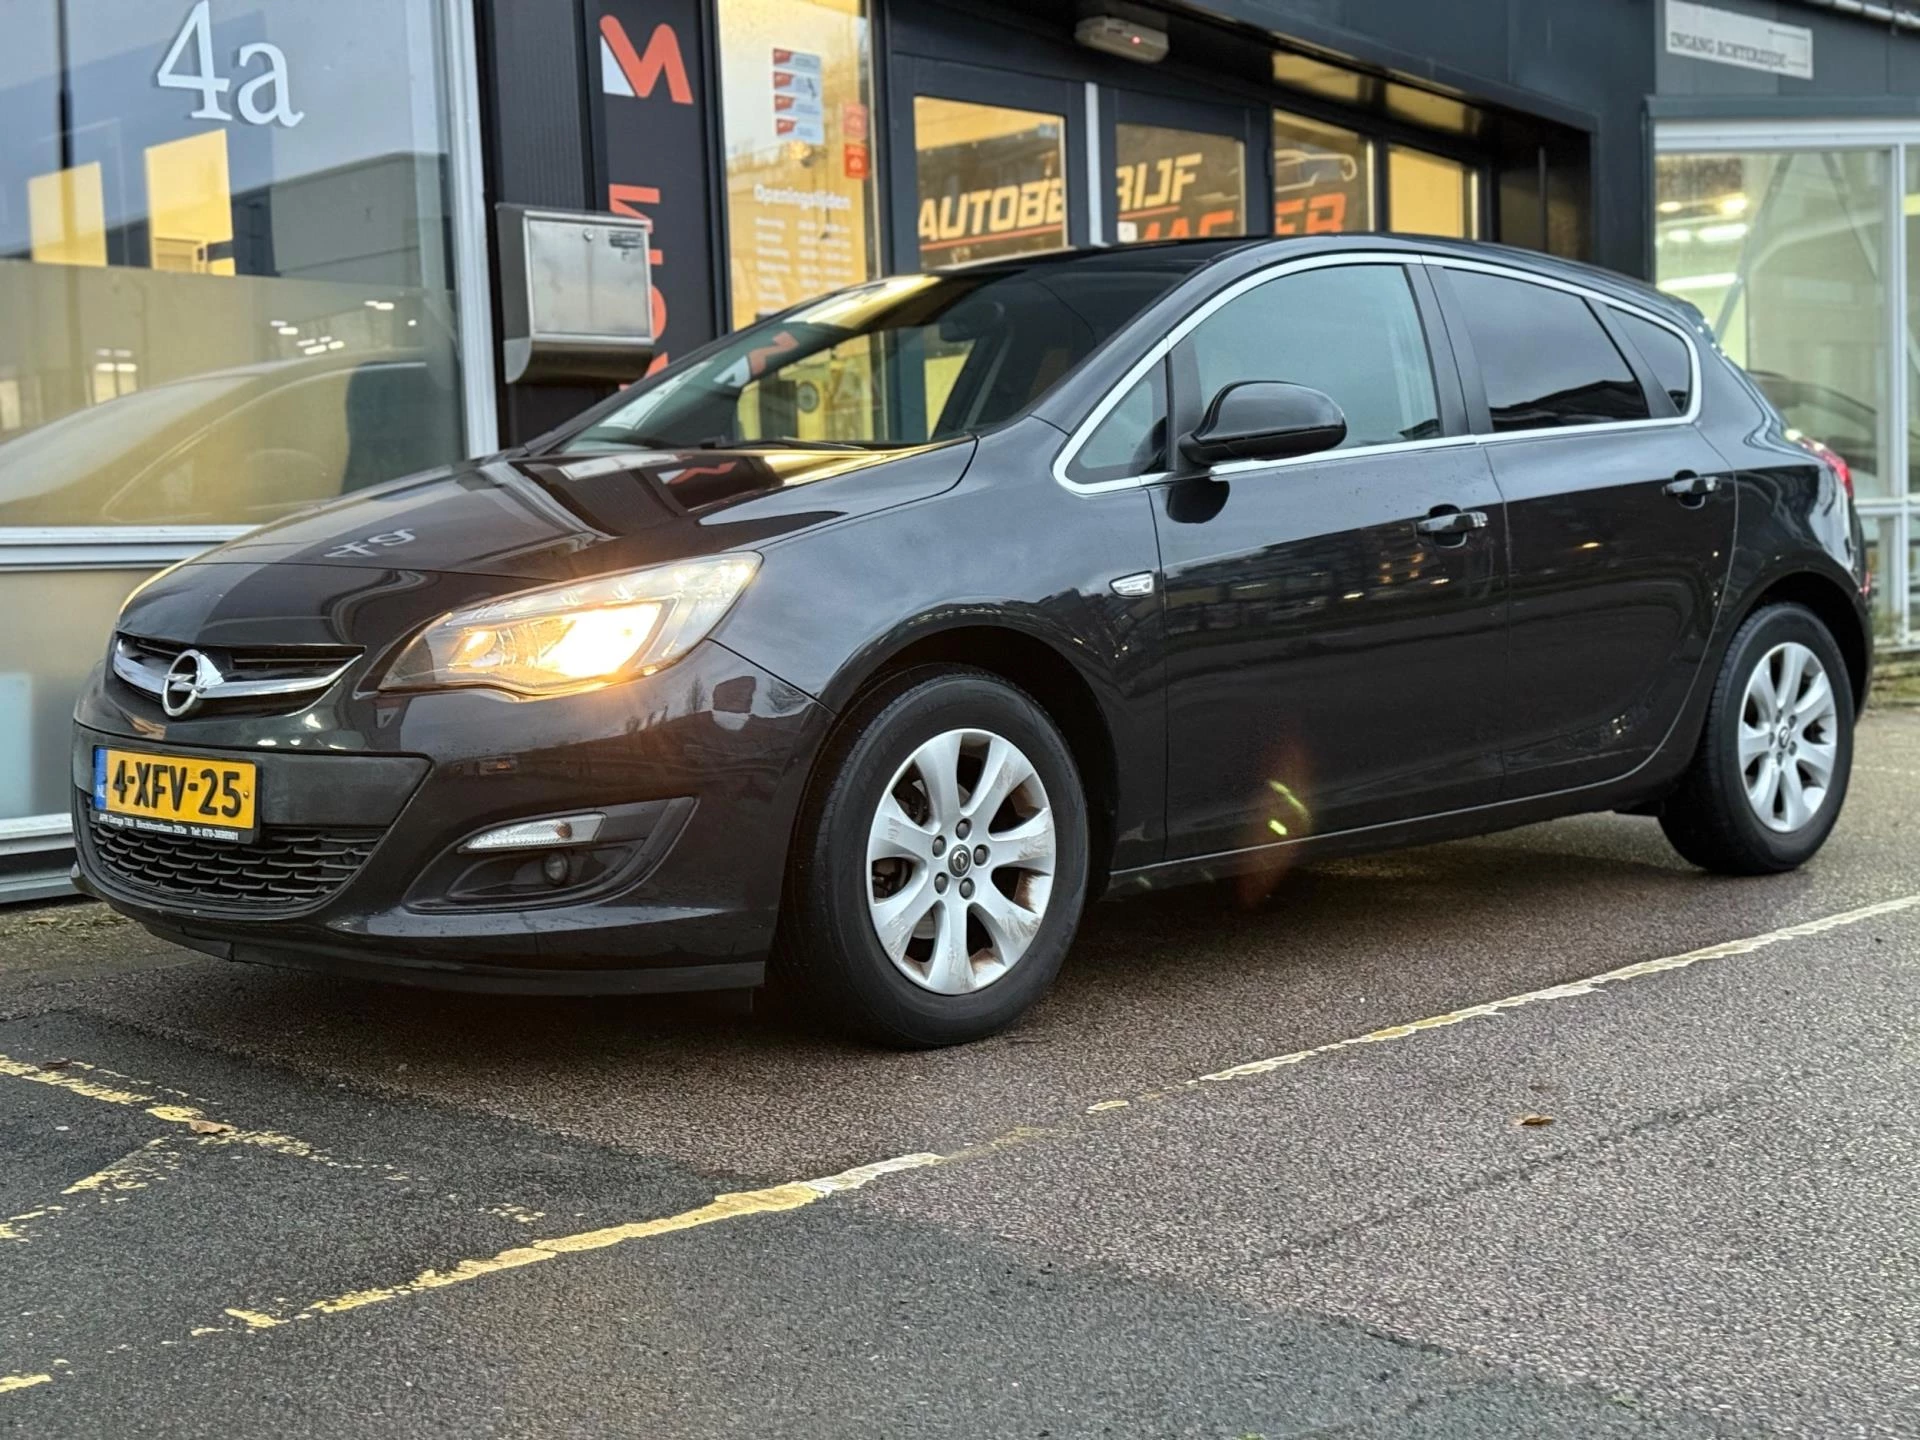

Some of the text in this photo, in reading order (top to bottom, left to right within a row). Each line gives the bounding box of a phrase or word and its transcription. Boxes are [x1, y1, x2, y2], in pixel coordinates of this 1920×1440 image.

[157, 0, 304, 127] 4a
[1670, 31, 1714, 54] INGANG
[113, 760, 241, 818] 4-XFV-25
